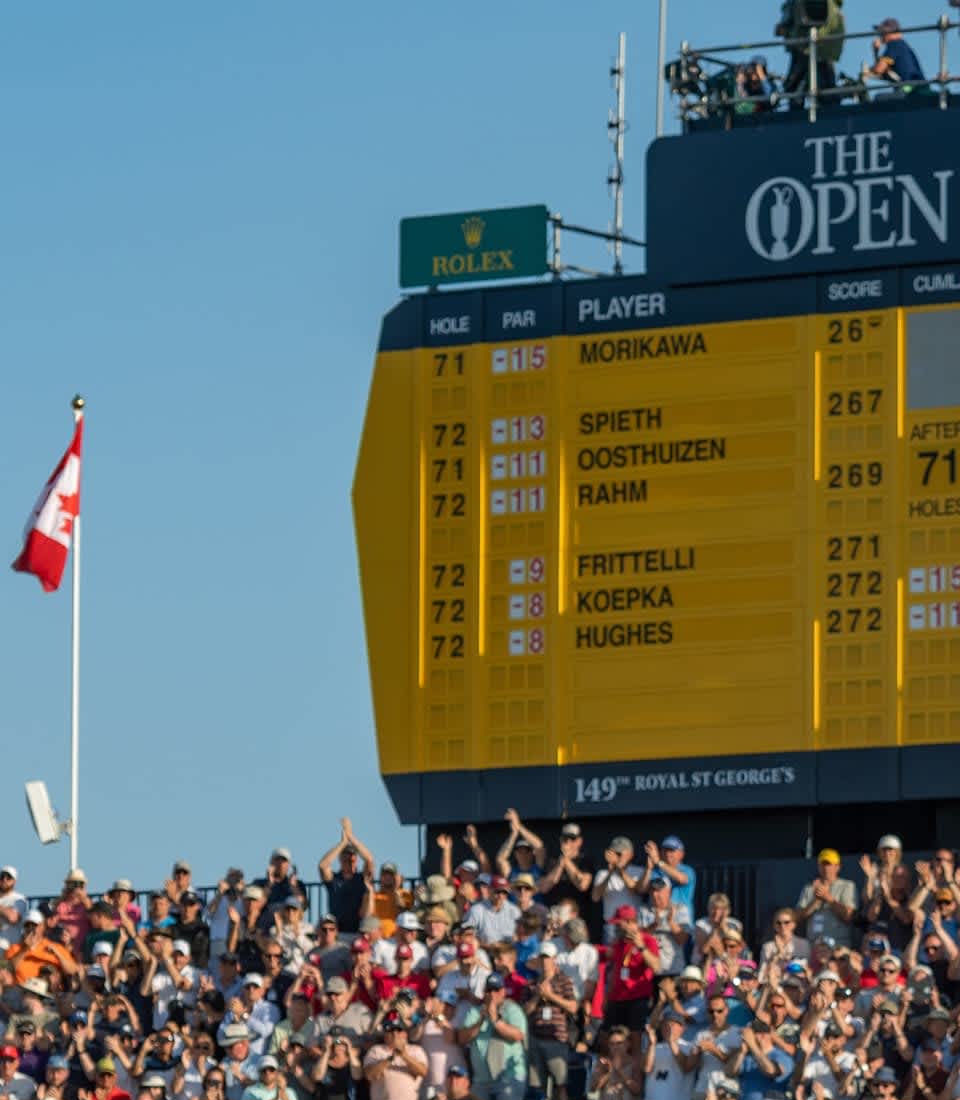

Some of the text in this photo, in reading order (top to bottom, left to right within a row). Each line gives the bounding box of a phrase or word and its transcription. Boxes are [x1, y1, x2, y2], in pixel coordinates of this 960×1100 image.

[805, 131, 894, 180] THE
[745, 171, 953, 261] OPEN
[431, 249, 514, 277] ROLEX
[828, 279, 883, 300] SCORE
[502, 310, 536, 329] PAR
[578, 293, 665, 323] PLAYER
[430, 315, 470, 336] HOLE
[494, 346, 546, 371] -15
[579, 332, 707, 365] MORIKAWA
[433, 352, 465, 377] 71
[827, 388, 883, 417] 267
[494, 415, 545, 441] -13
[578, 407, 662, 436] SPIETH
[433, 423, 467, 448] 72
[494, 451, 543, 478] -11
[577, 438, 726, 472] OOSTHUIZEN
[917, 448, 957, 487] 71
[433, 459, 464, 482] 71
[827, 462, 883, 490] 269
[433, 494, 466, 518] 72
[494, 487, 543, 514] -11
[578, 480, 648, 508] RAHM
[827, 535, 882, 561] 271
[512, 557, 544, 584] -9
[577, 547, 695, 578] FRITTELLI
[432, 564, 465, 589] 72
[827, 571, 883, 598] 272
[432, 600, 465, 624] 72
[512, 592, 544, 618] -8
[576, 585, 674, 614] KOEPKA
[826, 607, 883, 634] 272
[432, 635, 465, 659] 72
[512, 629, 544, 654] -8
[575, 621, 673, 650] HUGHES
[635, 773, 687, 791] ROYAL
[690, 771, 713, 788] ST
[713, 766, 796, 787] GEORGE'S
